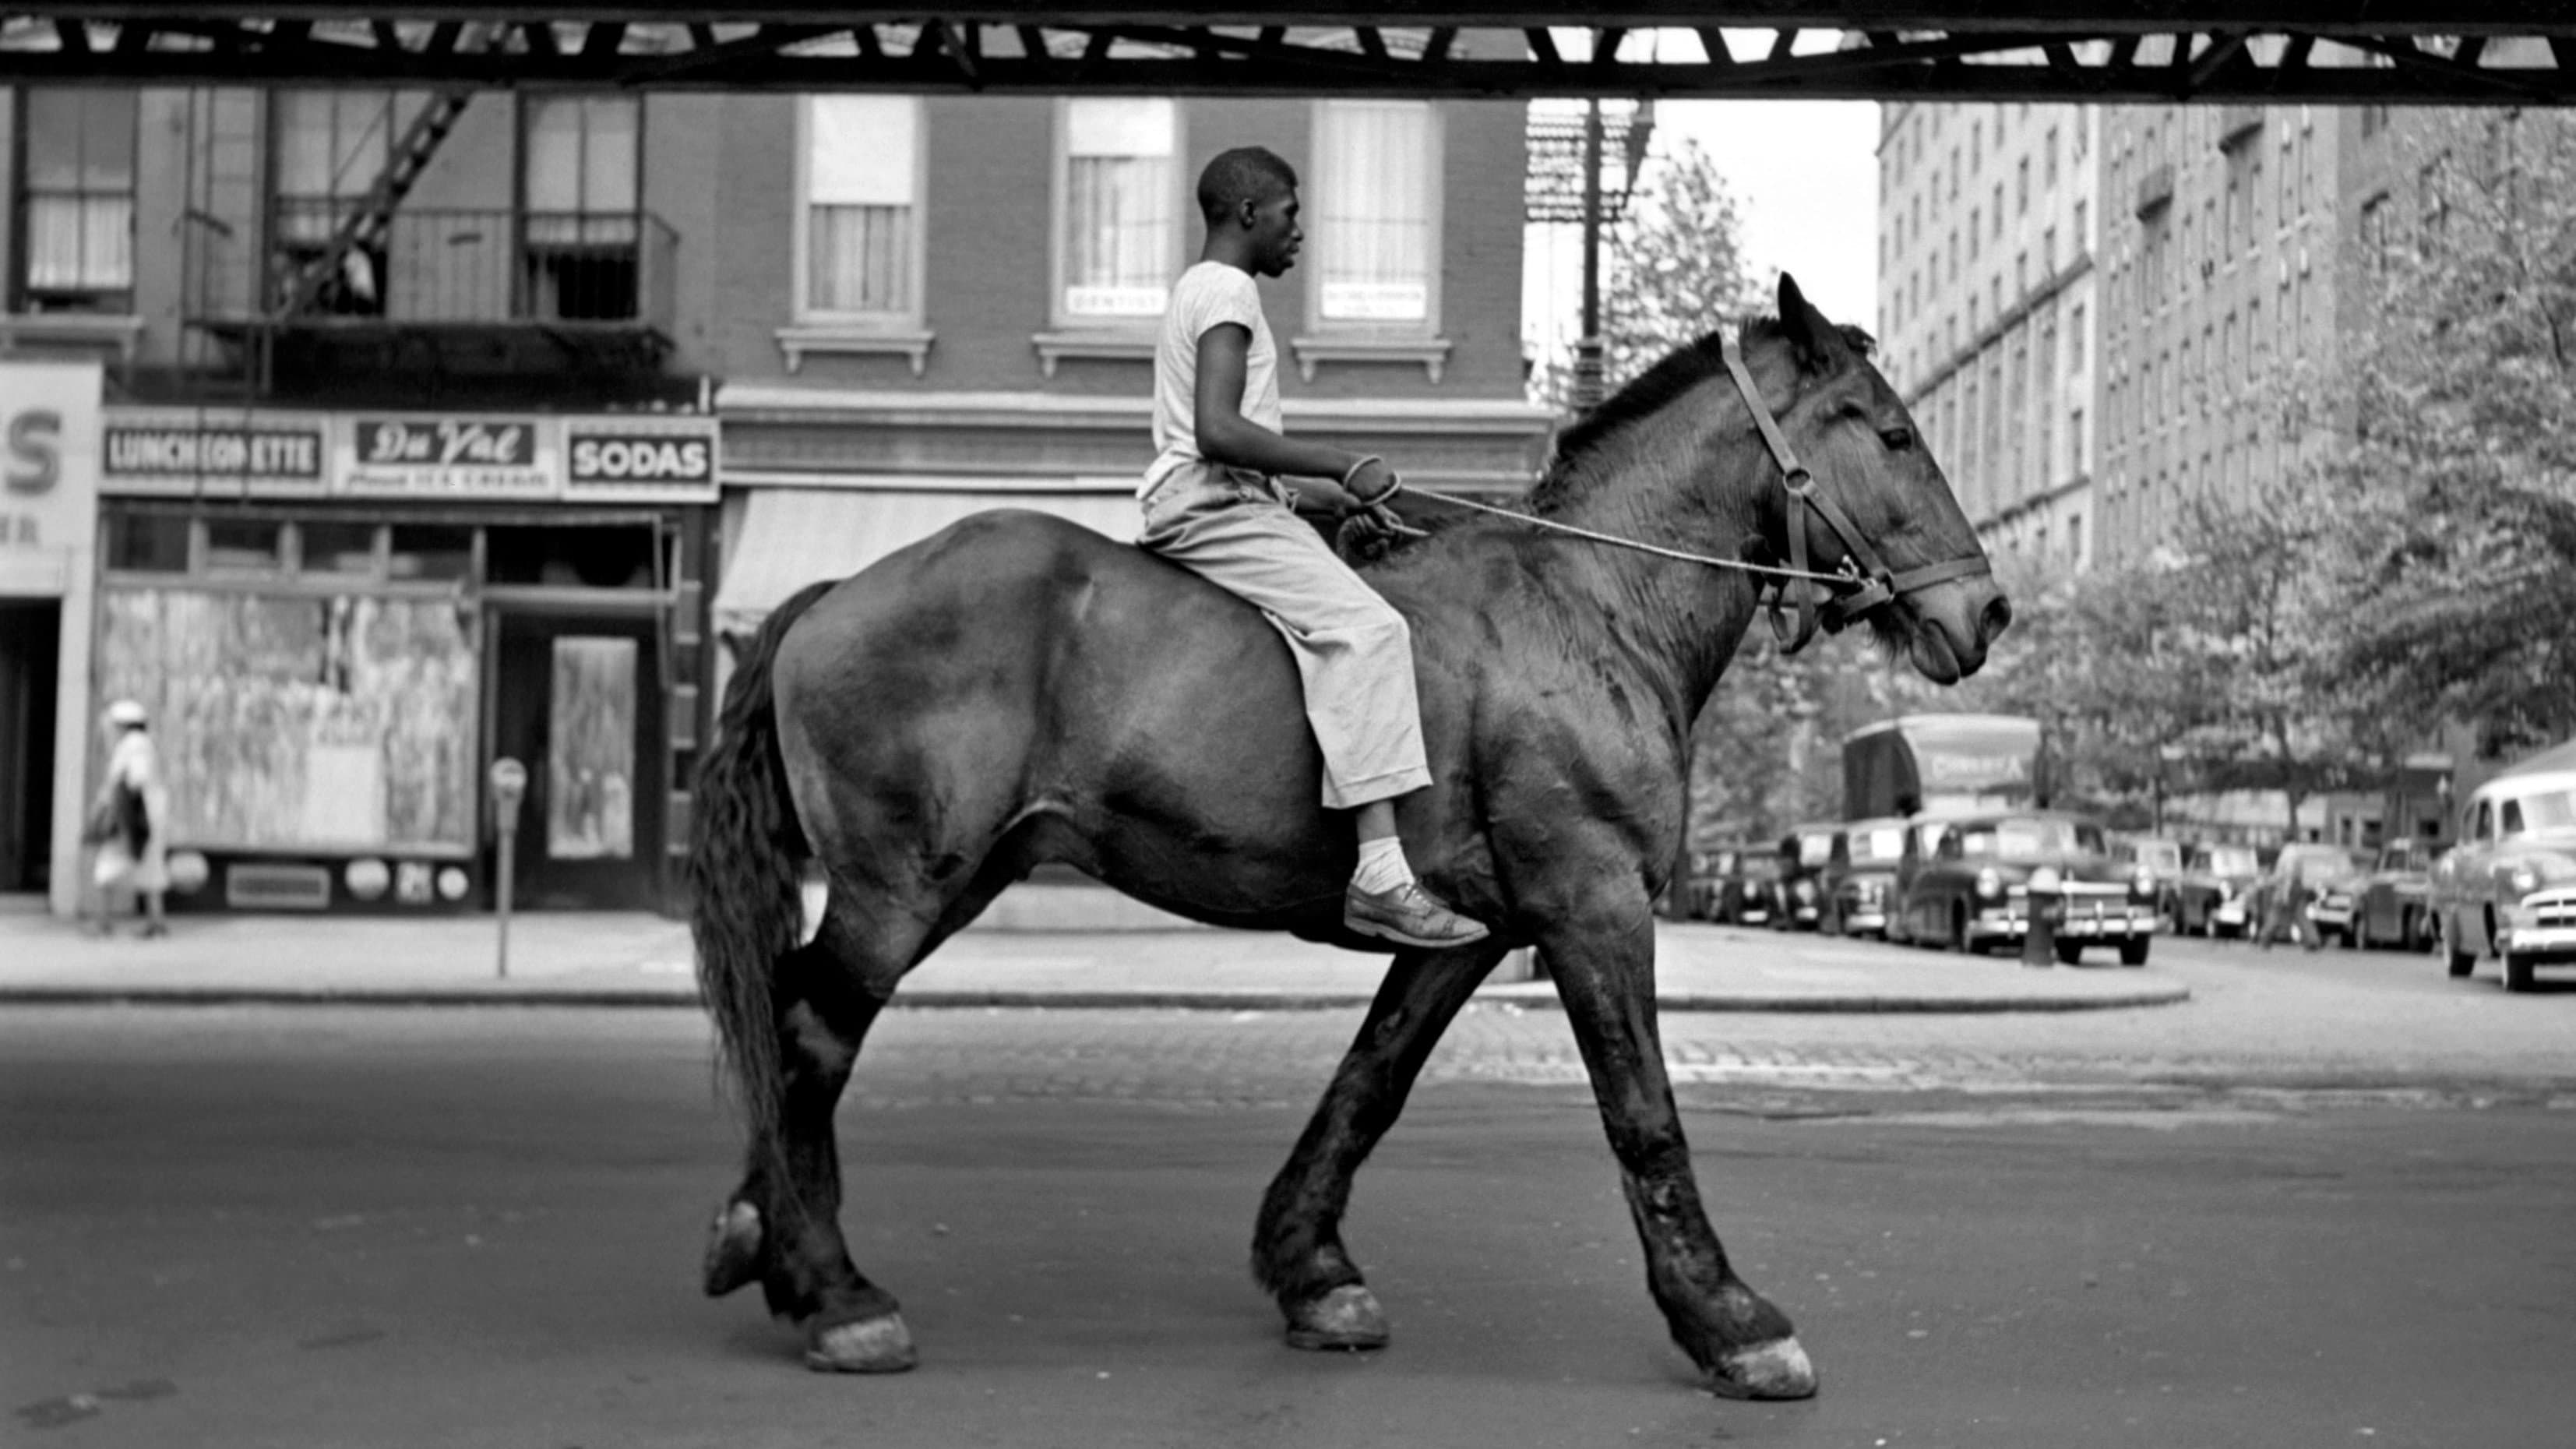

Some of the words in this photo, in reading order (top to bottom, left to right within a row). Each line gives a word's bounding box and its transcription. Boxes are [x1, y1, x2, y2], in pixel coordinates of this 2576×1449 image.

[109, 432, 315, 472] LUNCHEONETTE
[437, 418, 521, 466] Val
[573, 439, 707, 478] SODAS
